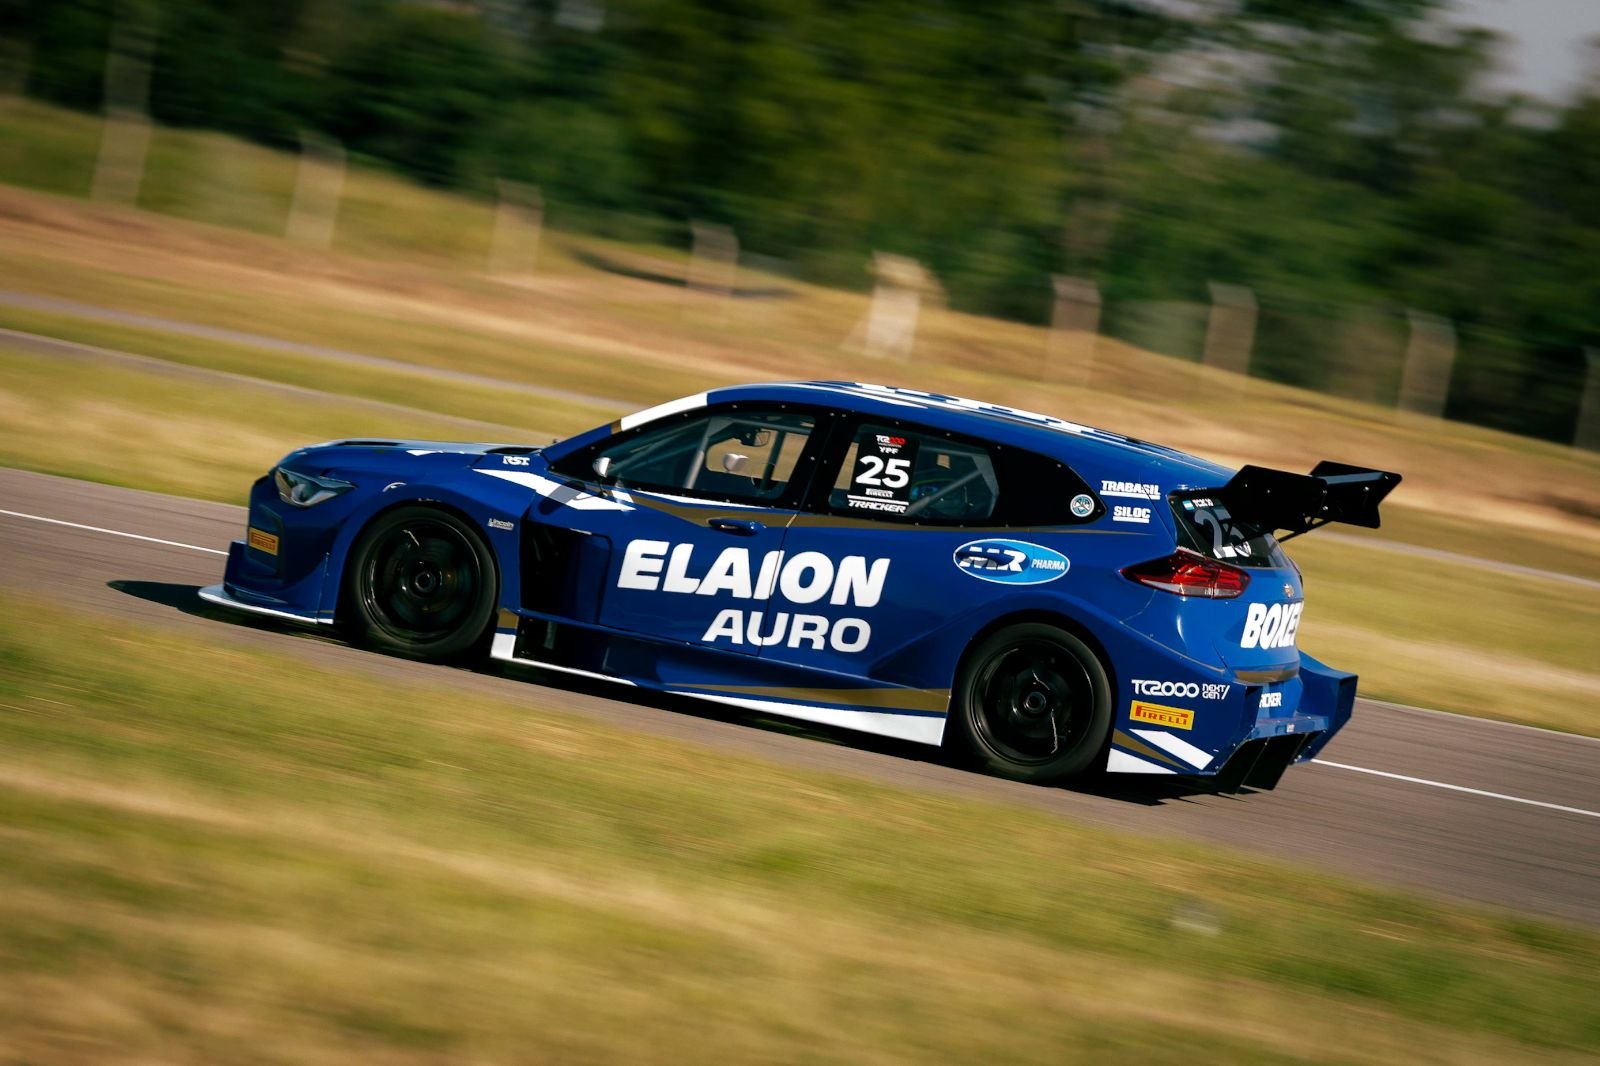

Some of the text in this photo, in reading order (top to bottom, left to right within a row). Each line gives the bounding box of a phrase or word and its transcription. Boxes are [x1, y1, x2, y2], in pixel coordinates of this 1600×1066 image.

[879, 446, 899, 454] YPF
[855, 455, 911, 488] 25
[1100, 480, 1160, 495] TRABASIL
[848, 500, 906, 513] TRACKER
[1113, 505, 1151, 519] SILOC
[617, 539, 891, 608] ELAION
[1031, 559, 1066, 571] PHARMA
[701, 608, 872, 653] AURO
[1240, 602, 1304, 650] BOXE
[1131, 680, 1200, 698] TC2000
[1135, 704, 1189, 726] PIRELLI
